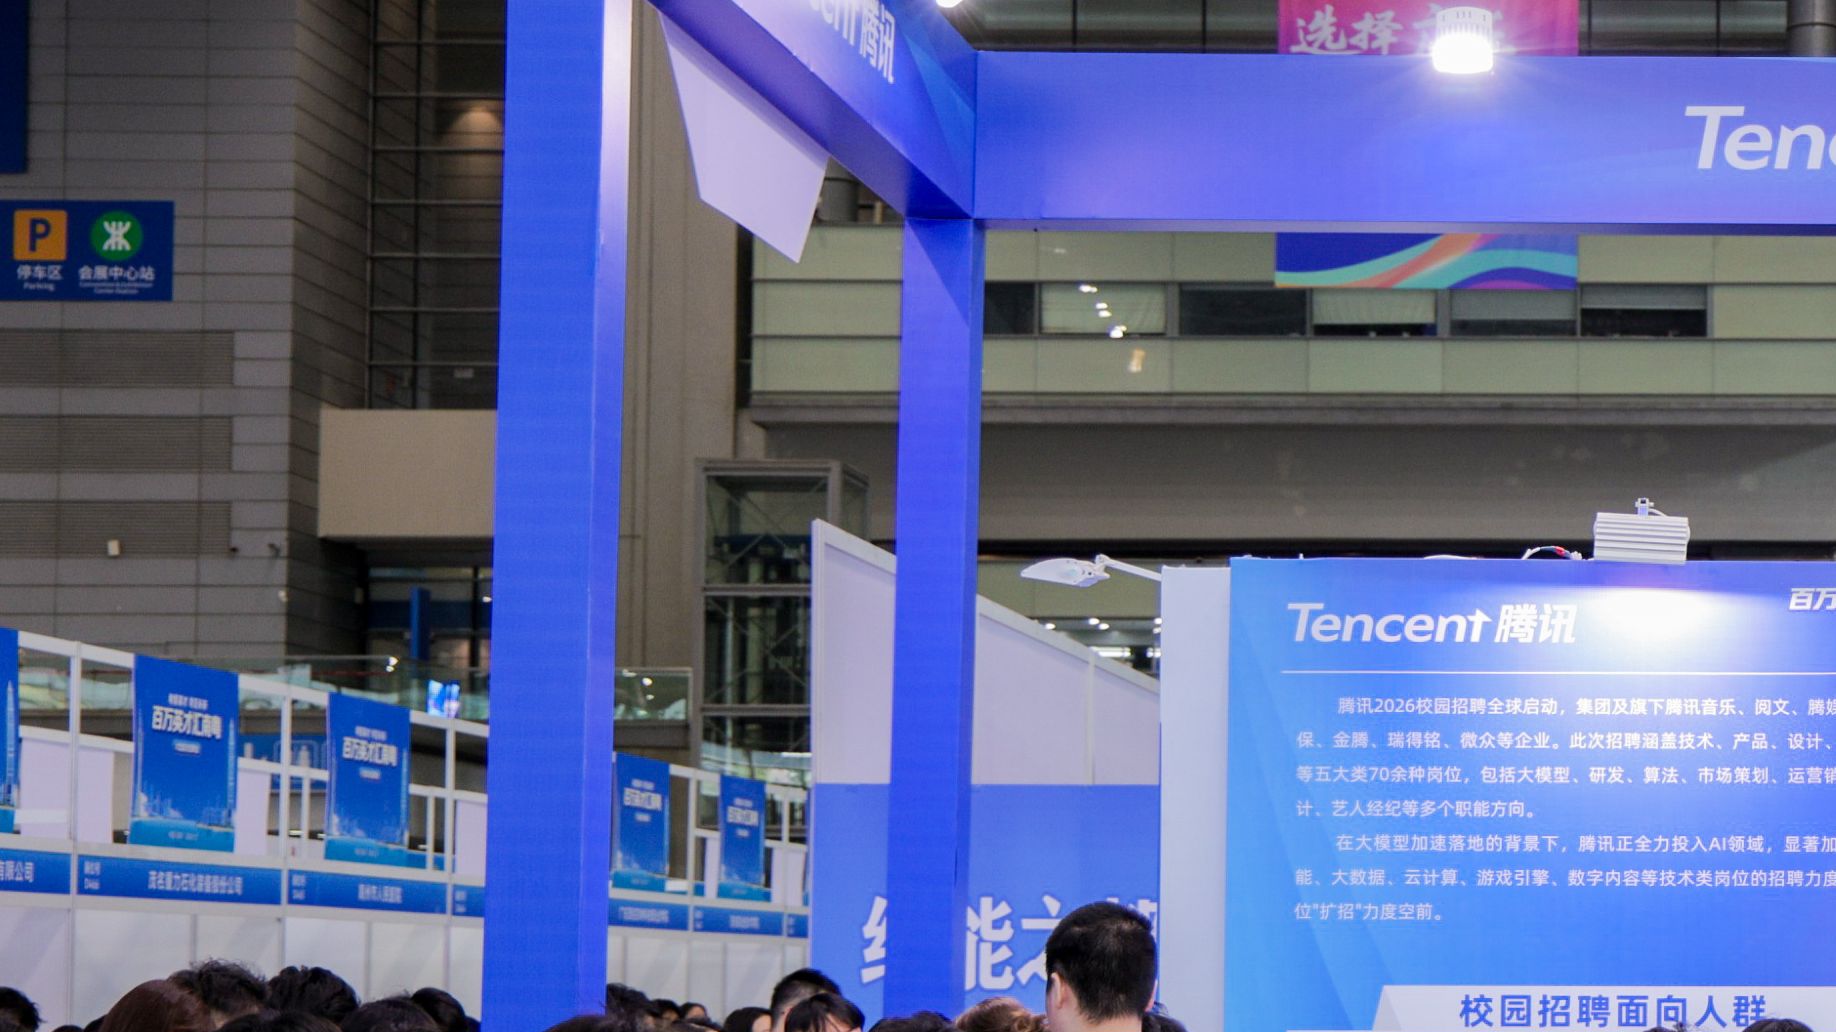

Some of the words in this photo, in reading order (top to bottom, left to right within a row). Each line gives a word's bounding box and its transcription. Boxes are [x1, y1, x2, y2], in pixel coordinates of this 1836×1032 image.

[17, 264, 62, 280] 停车区
[78, 264, 155, 281] 会展中心站
[1287, 603, 1492, 643] Tencent
[1494, 603, 1577, 644] 腾讯
[1295, 799, 1535, 819] 计、艺人经纪等多个职能方向。
[1459, 994, 1767, 1028] 校园招聘面向人群
